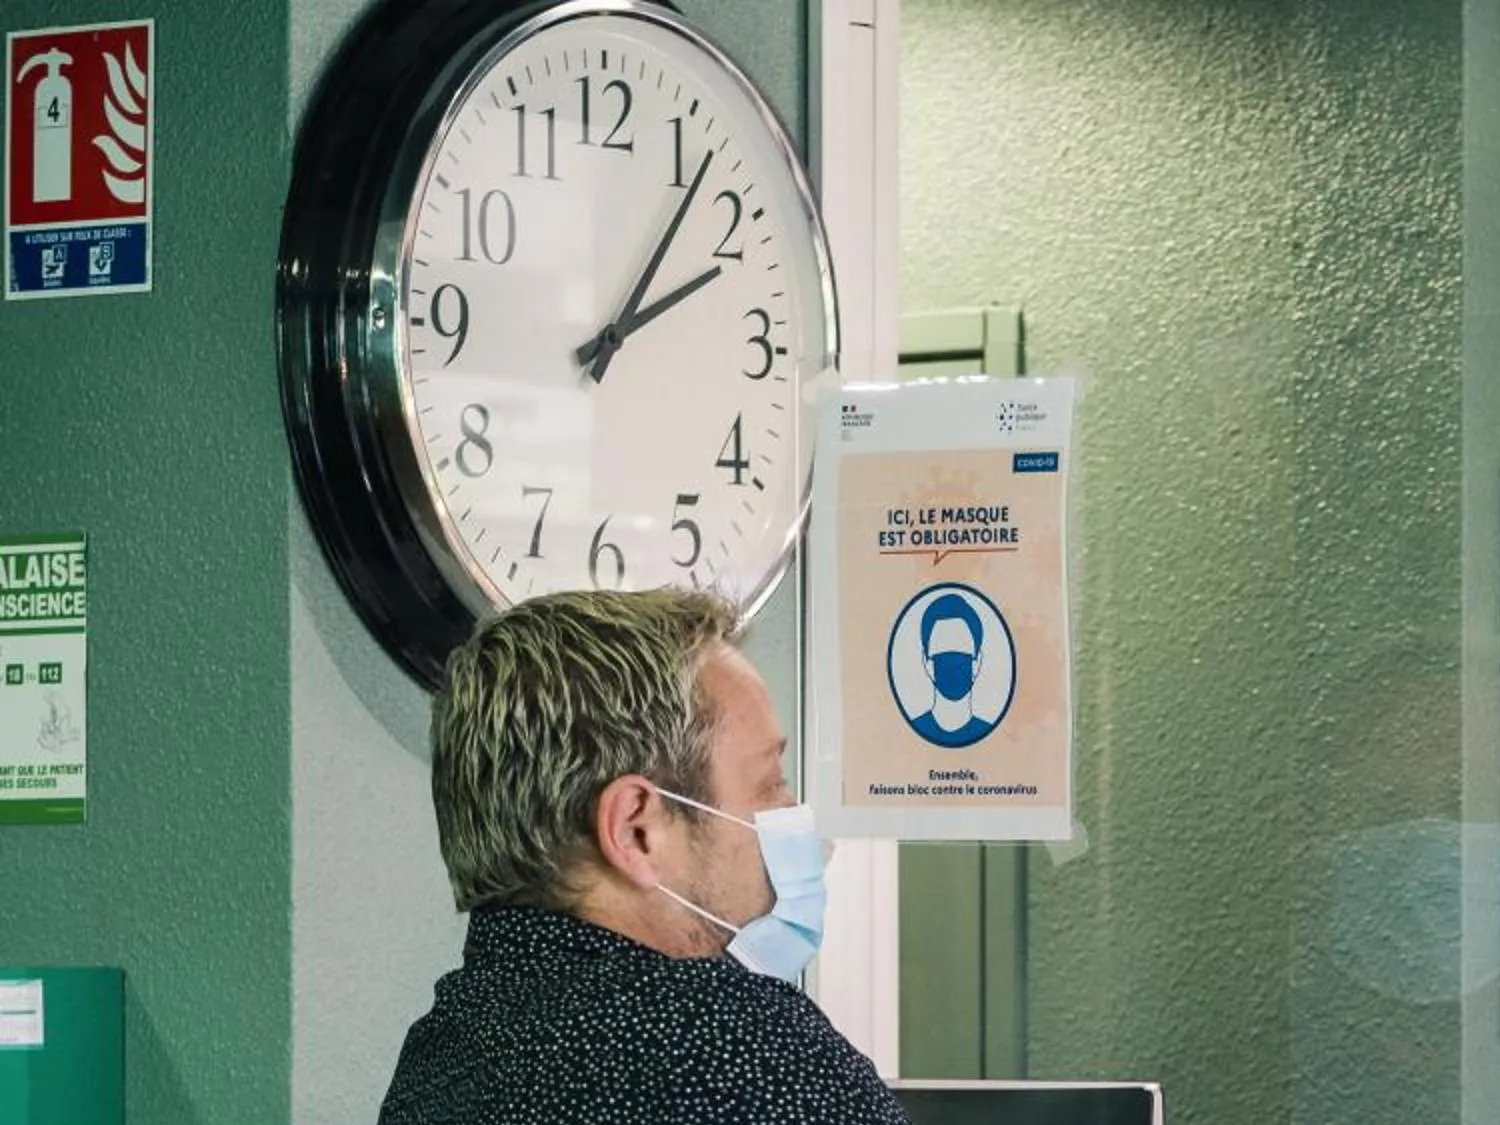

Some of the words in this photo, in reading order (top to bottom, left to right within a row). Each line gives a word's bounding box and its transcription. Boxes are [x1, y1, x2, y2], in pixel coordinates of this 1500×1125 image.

[47, 96, 59, 123] 4
[509, 103, 562, 181] 11
[575, 75, 633, 152] 12
[666, 117, 690, 189] 1
[455, 188, 517, 264] 10
[711, 189, 744, 262] 2
[429, 283, 470, 366] 9
[742, 307, 774, 380] 3
[454, 402, 493, 477] 8
[714, 411, 750, 486] 4
[520, 486, 553, 558] 7
[588, 513, 625, 590] 6
[669, 493, 700, 568] 5
[879, 530, 906, 546] EST
[910, 528, 1019, 545] OBLIGATOIRE
[887, 509, 914, 527] ICI,
[919, 508, 936, 524] LE
[941, 506, 1009, 525] MASQUE
[869, 784, 905, 796] faisons
[908, 784, 929, 795] bloc
[932, 785, 963, 795] contre
[965, 784, 975, 795] le
[978, 784, 1038, 796] coronavirus
[929, 769, 979, 782] Ensemble,
